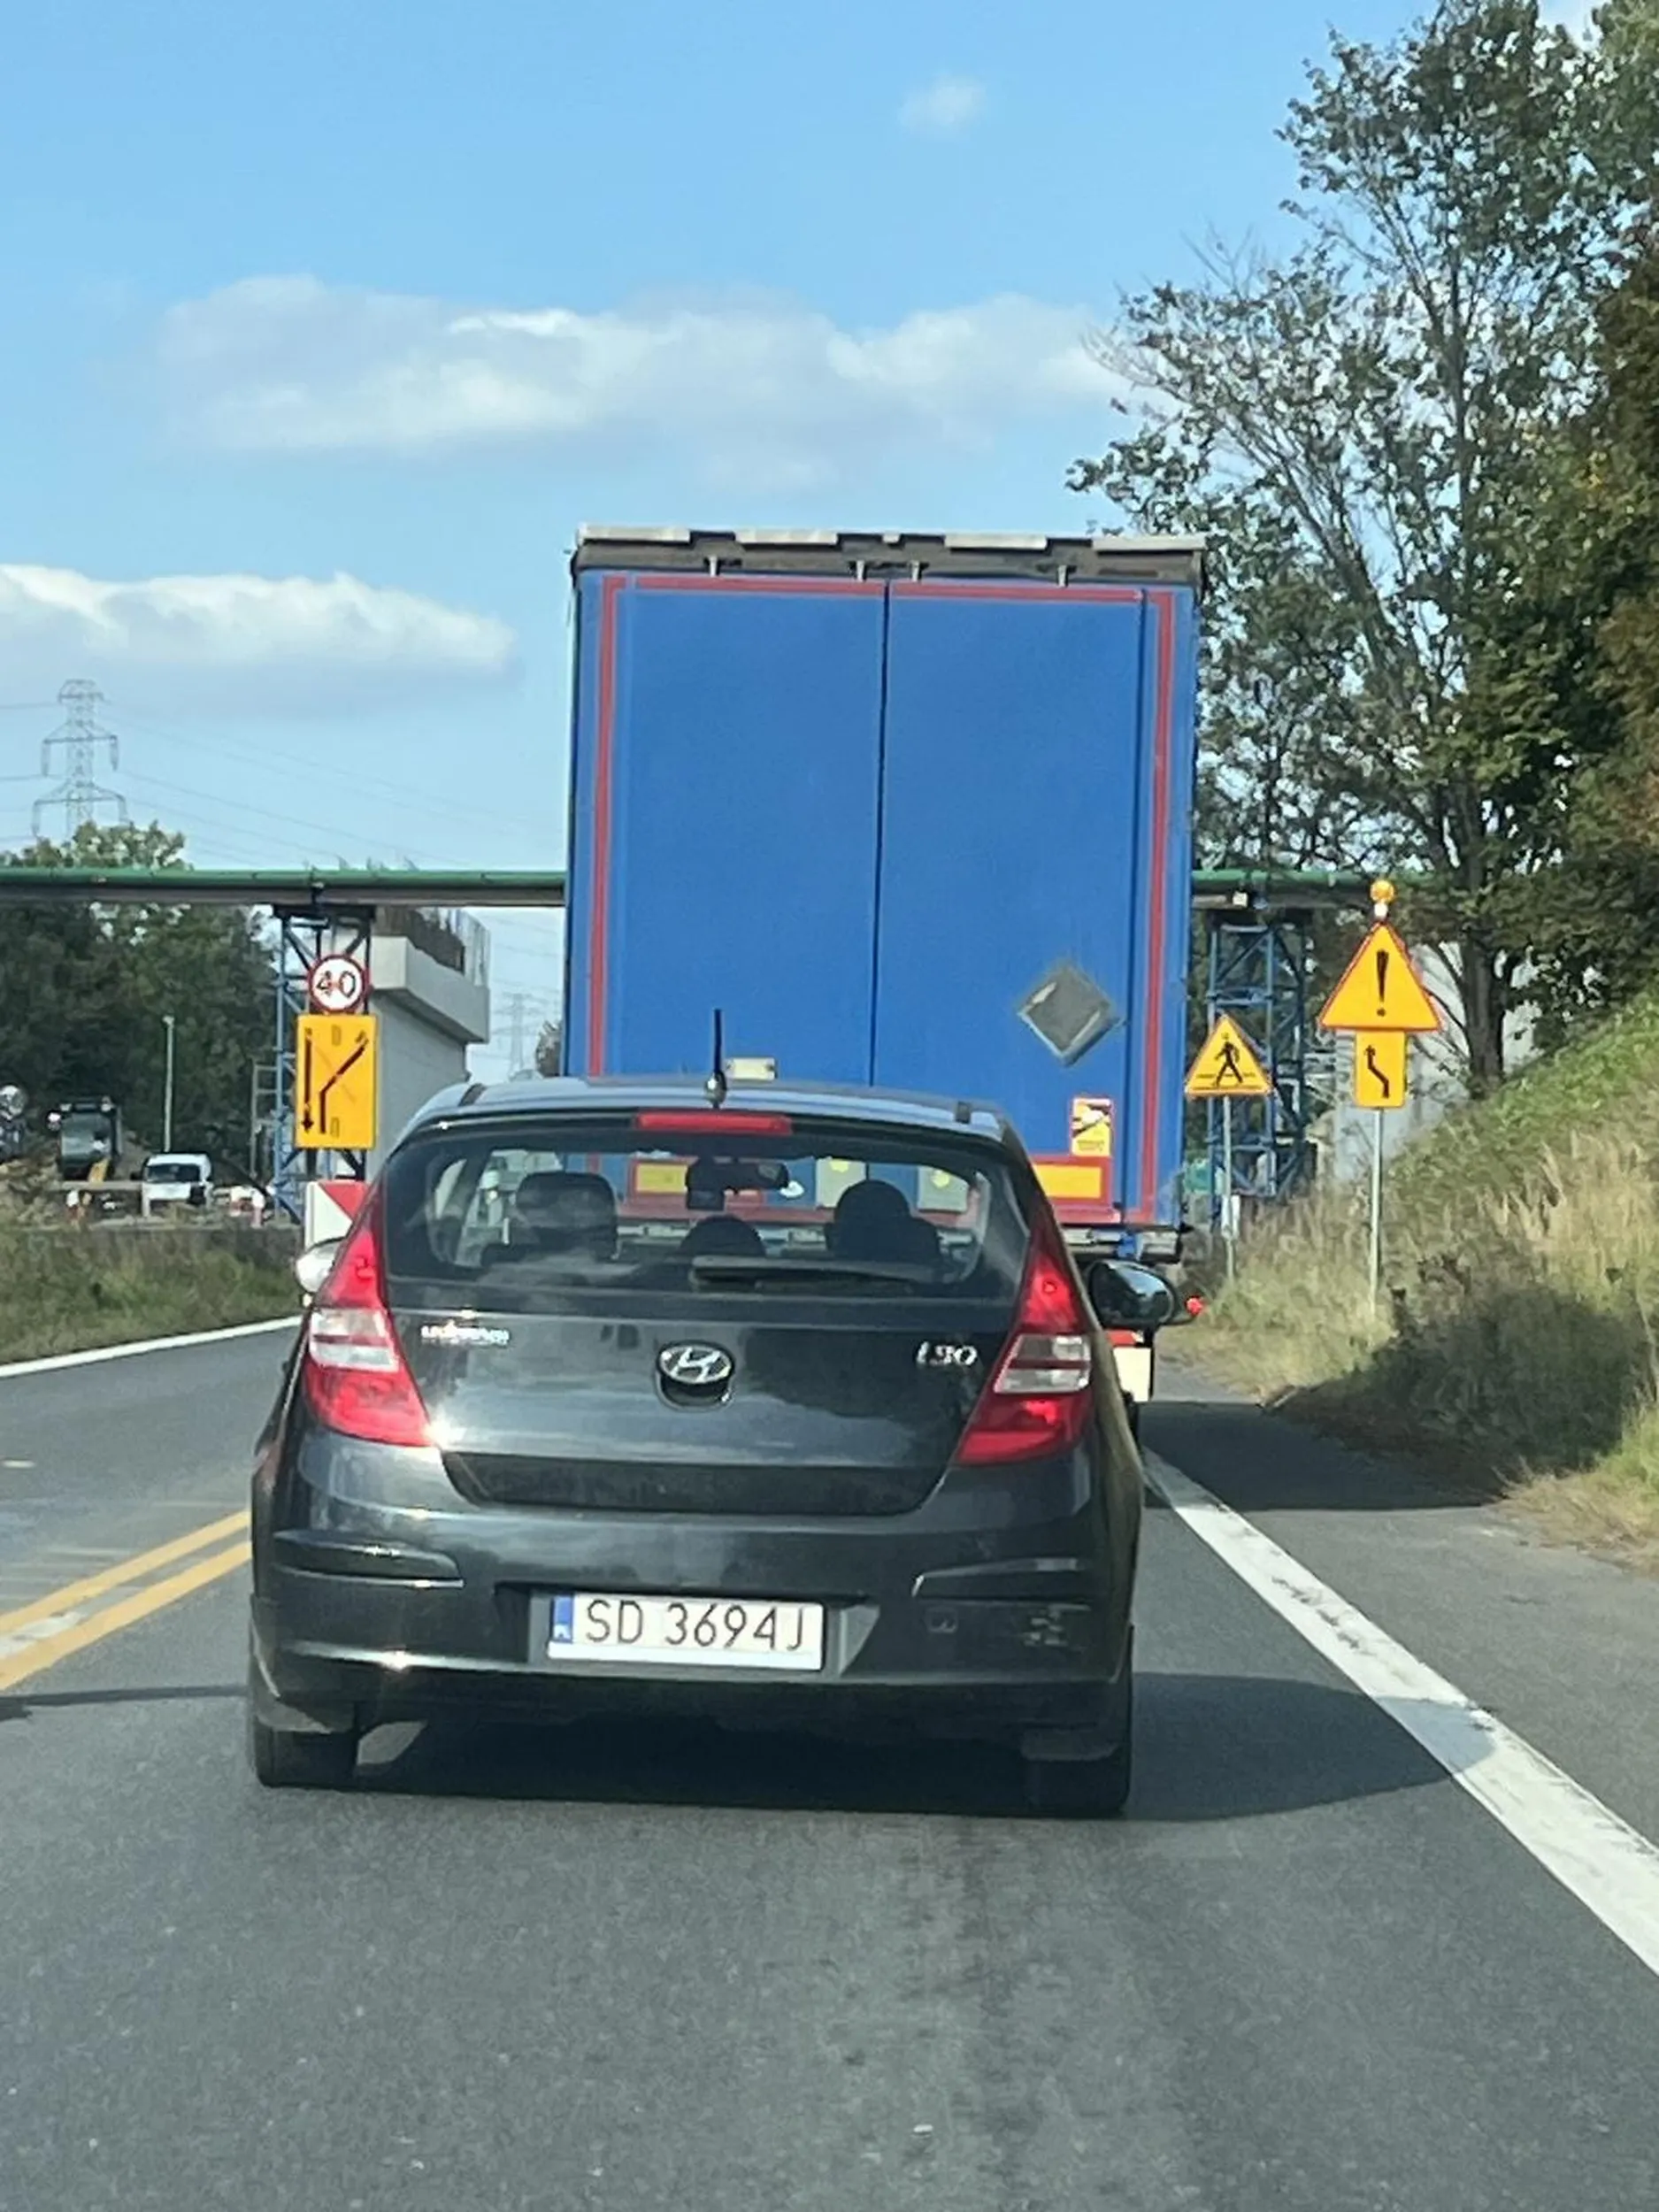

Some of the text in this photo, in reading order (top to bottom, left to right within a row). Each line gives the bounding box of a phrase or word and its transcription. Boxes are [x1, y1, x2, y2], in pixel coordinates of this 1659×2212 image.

[316, 970, 357, 999] 40
[587, 1599, 803, 1651] SD 3694J
